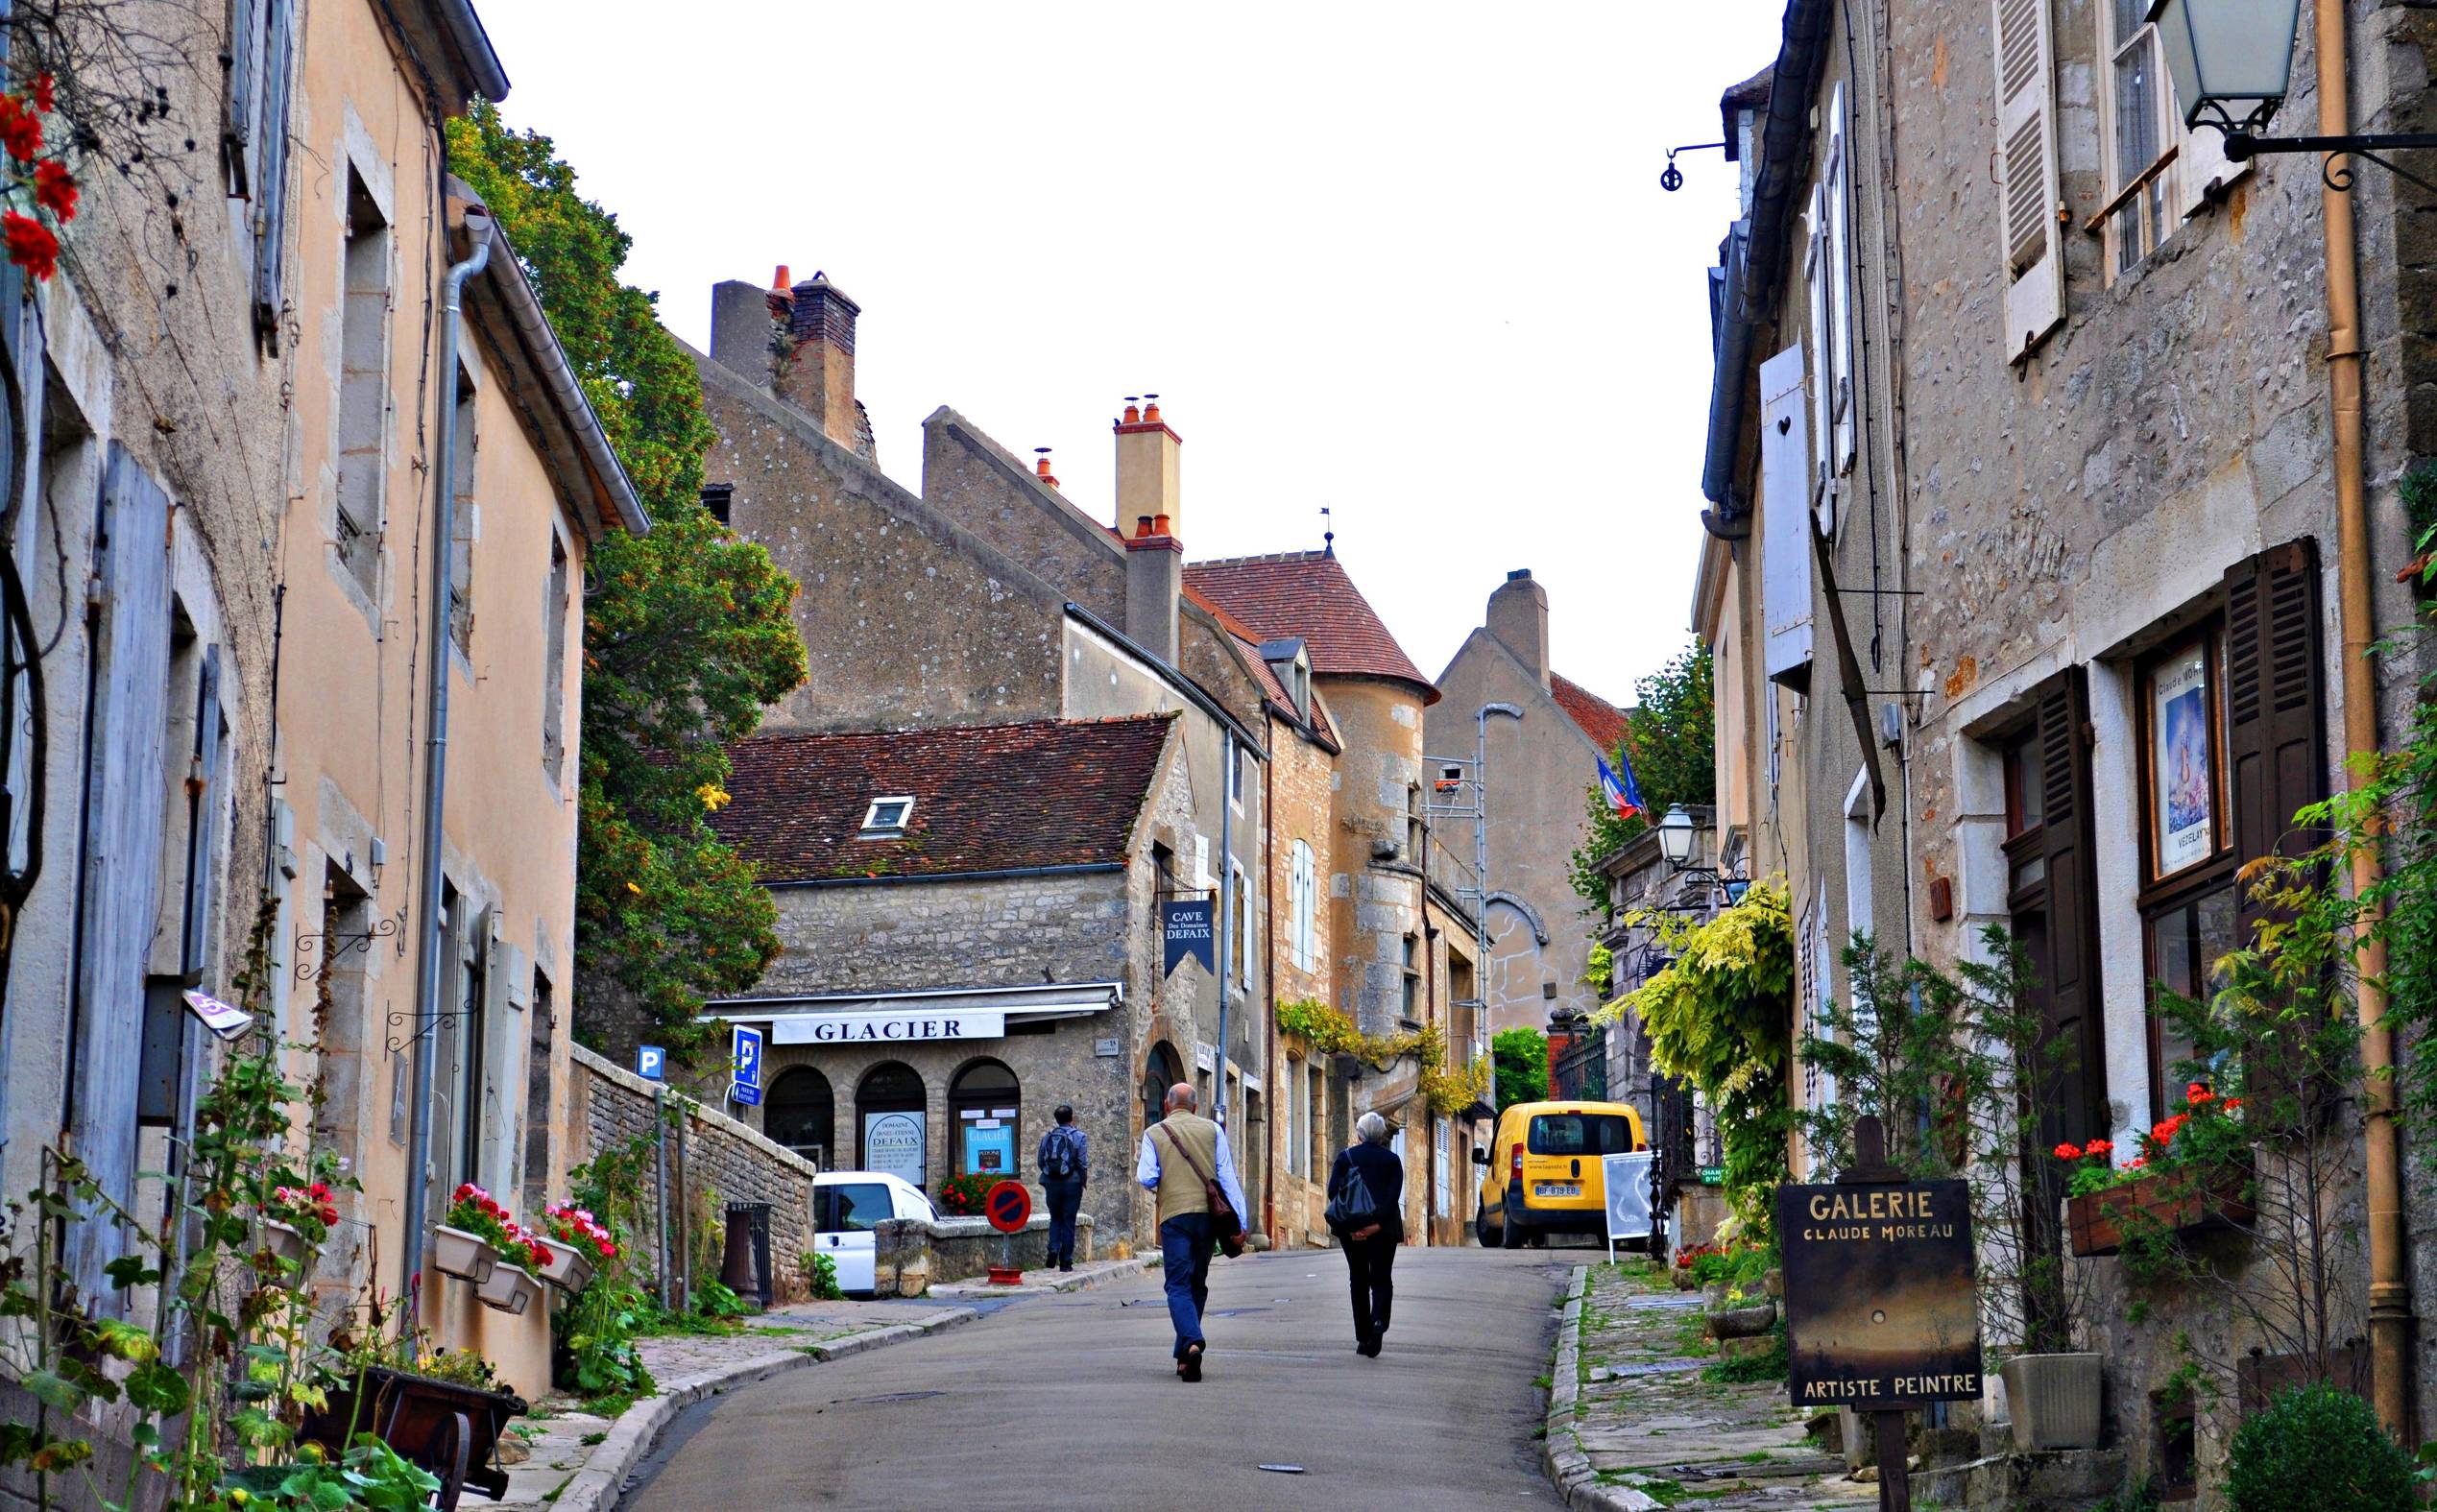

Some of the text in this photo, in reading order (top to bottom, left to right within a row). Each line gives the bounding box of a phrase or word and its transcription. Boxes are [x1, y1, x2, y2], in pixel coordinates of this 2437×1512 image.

[2159, 676, 2182, 695] Claude
[1172, 912, 1203, 922] CAVE
[1167, 929, 1210, 939] DEFAIX
[815, 1020, 961, 1041] GLACIER
[641, 1051, 659, 1073] P
[740, 1039, 754, 1074] P
[874, 1137, 918, 1145] DEFAIX
[970, 1129, 1008, 1140] GLACIER
[1809, 1191, 1934, 1221] GALERIE
[1804, 1224, 1953, 1242] CLAUDE MOREAU
[1804, 1374, 1977, 1399] ARTISTE PEINTRE
